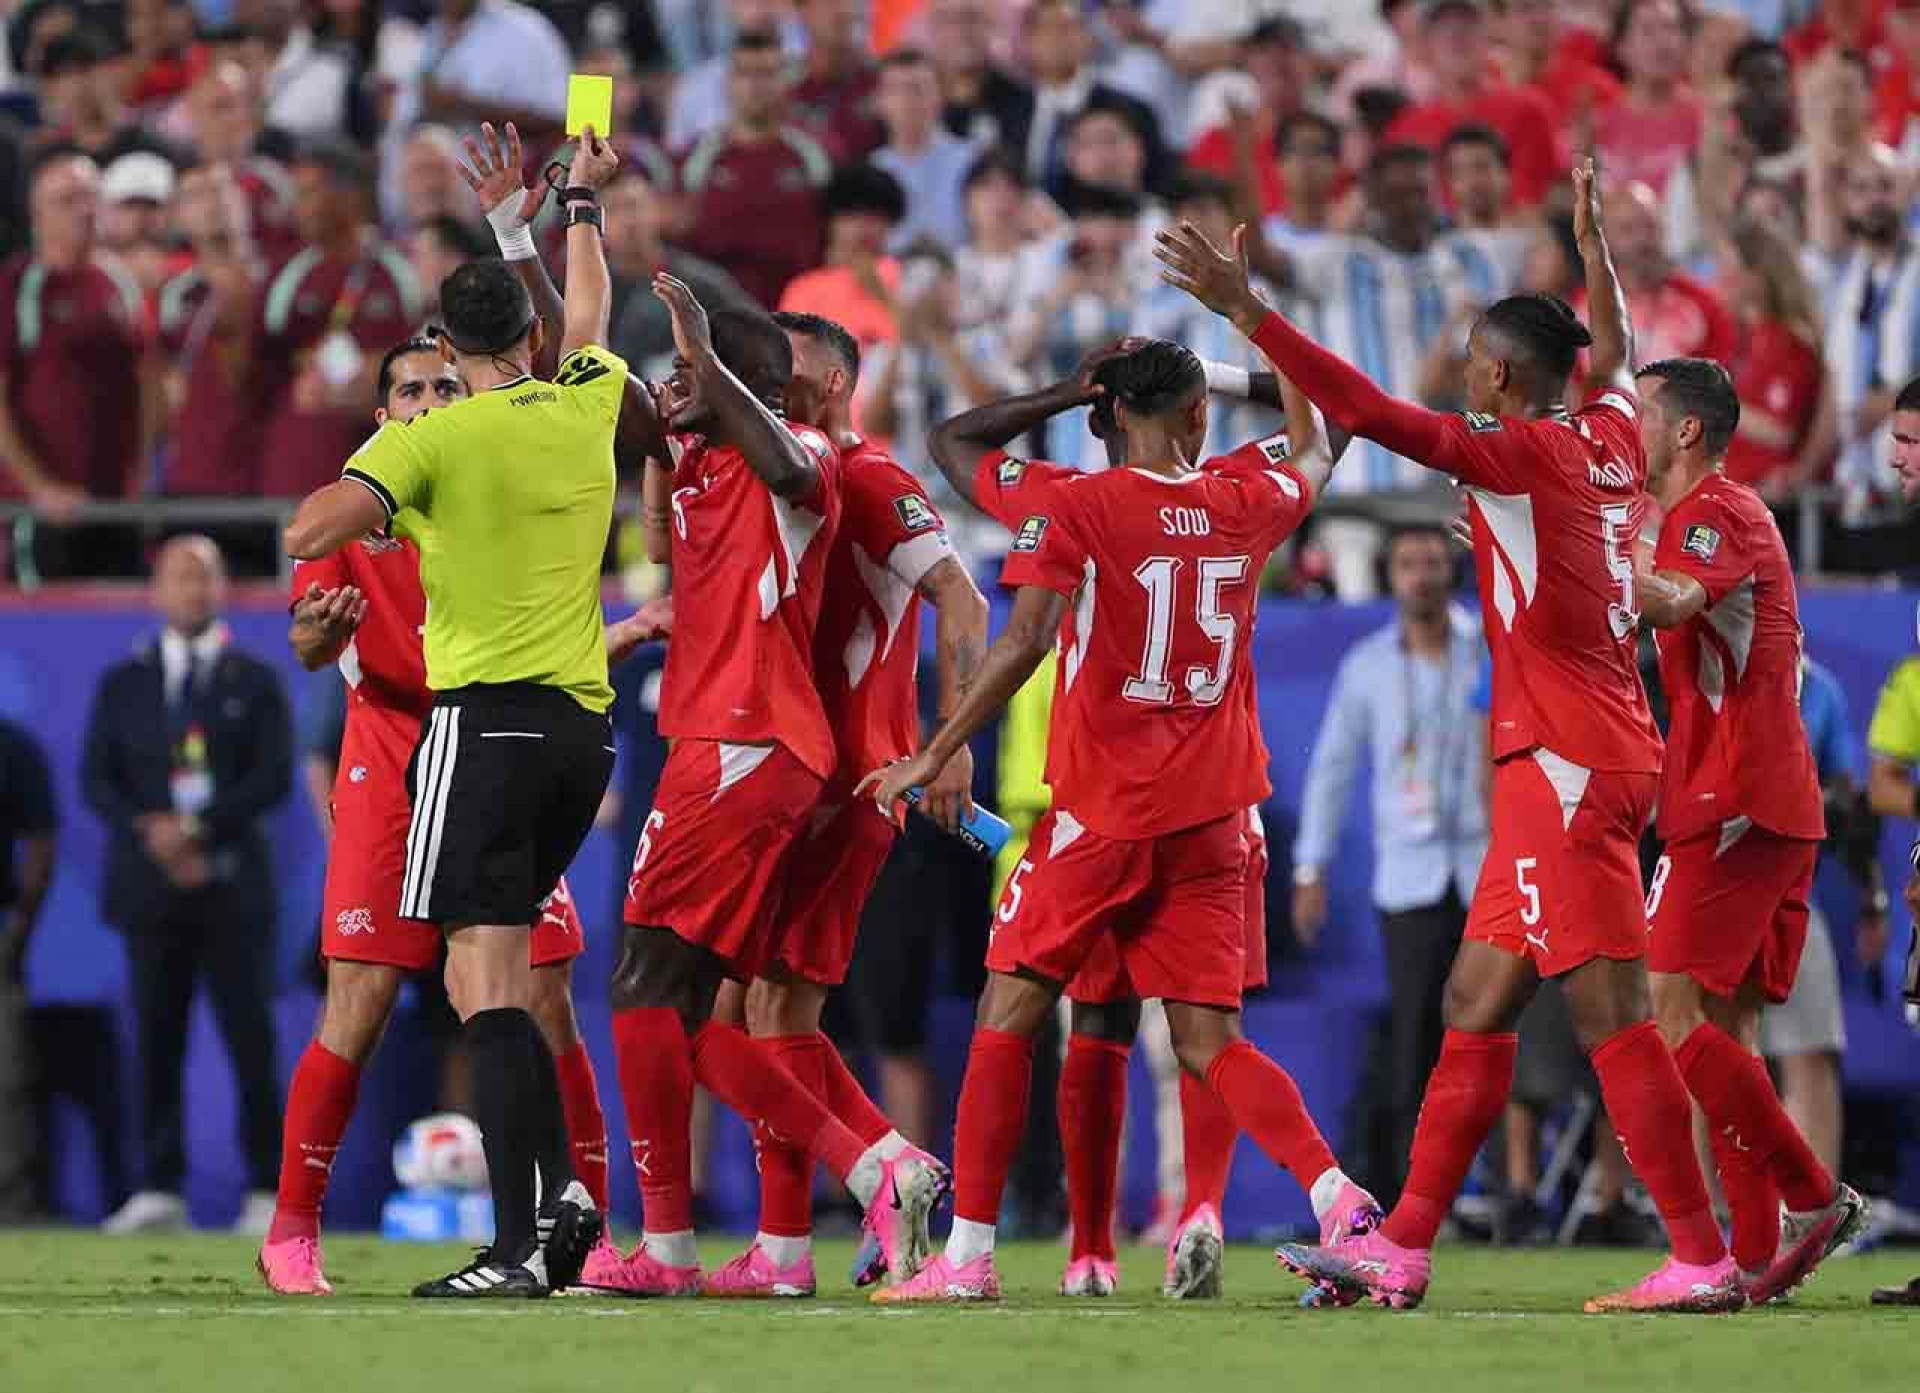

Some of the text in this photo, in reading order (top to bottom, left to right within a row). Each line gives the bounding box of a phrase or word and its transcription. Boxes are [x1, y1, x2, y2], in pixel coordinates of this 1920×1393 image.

[1160, 506, 1210, 535] SOW
[1599, 502, 1642, 643] 5
[1123, 554, 1250, 706] 15
[632, 808, 666, 874] 6
[1515, 856, 1540, 926] 5
